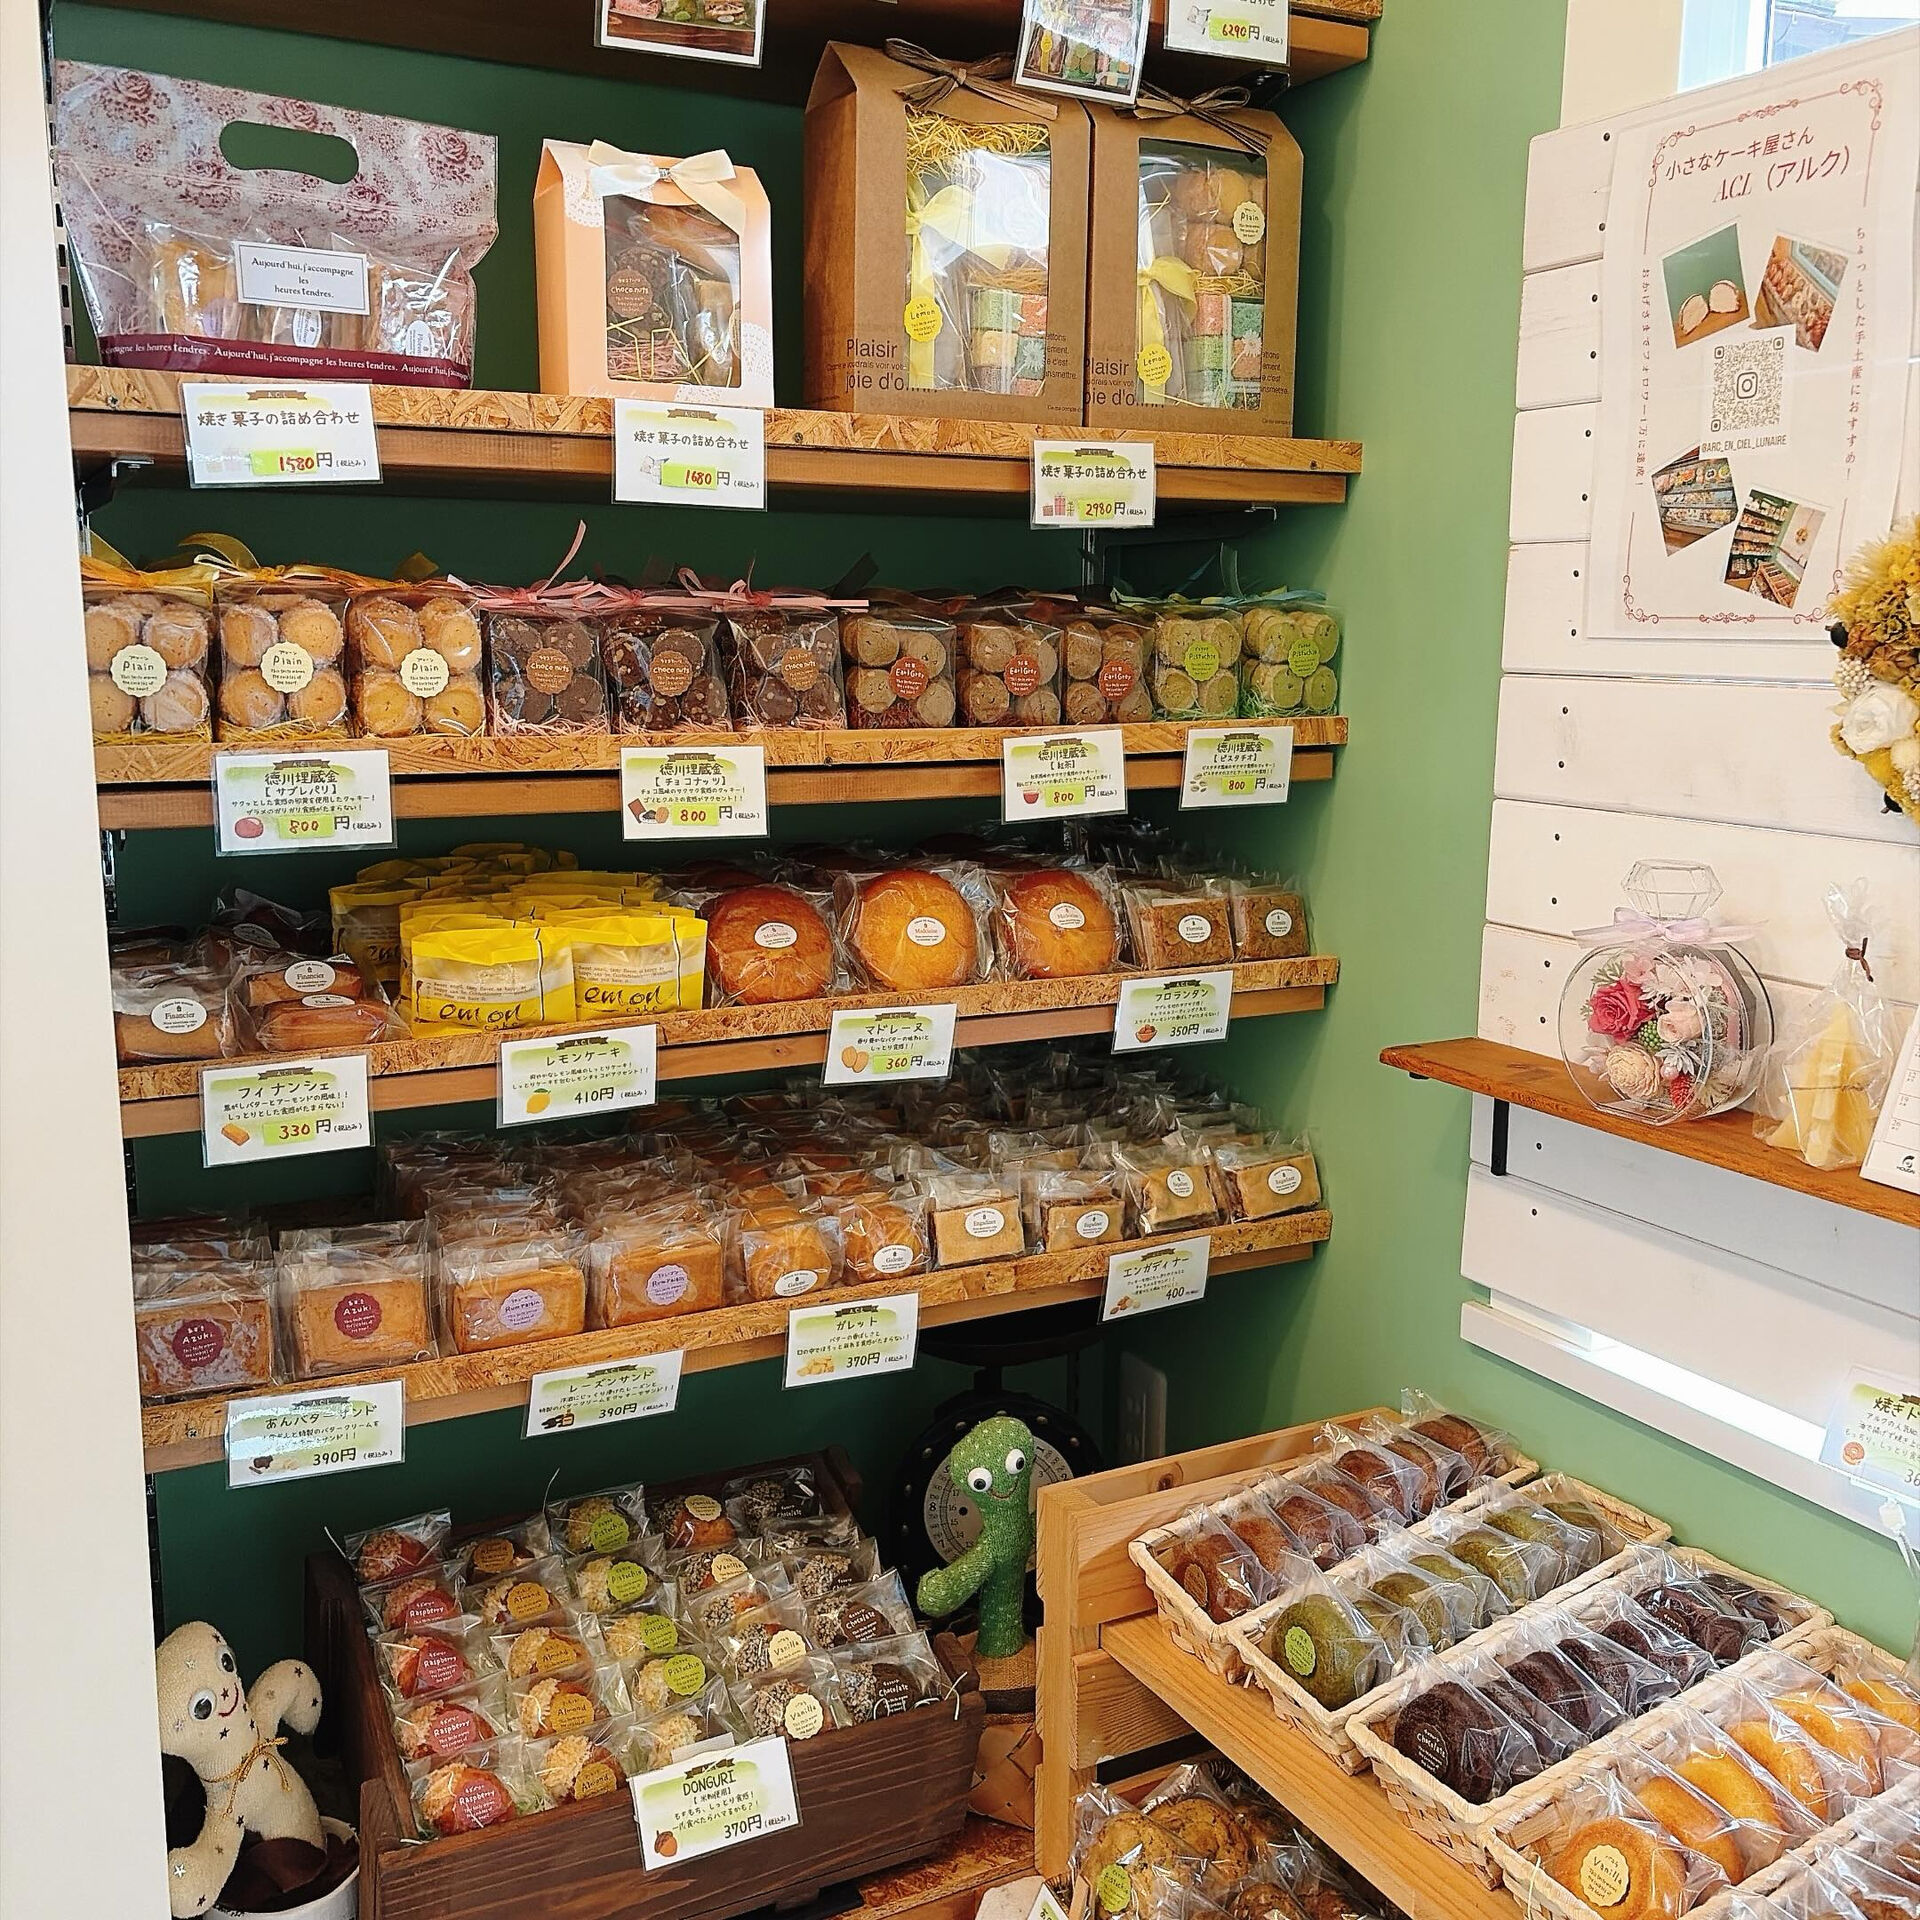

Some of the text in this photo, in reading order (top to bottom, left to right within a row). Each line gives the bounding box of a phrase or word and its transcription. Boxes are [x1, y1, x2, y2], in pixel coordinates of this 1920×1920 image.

[1665, 126, 1815, 181] 小さなケーキ屋さん
[1240, 211, 1259, 221] Plain
[298, 276, 310, 286] les
[274, 284, 335, 299] heures tendres.
[910, 309, 936, 320] Lemon
[846, 338, 898, 358] Plaisir
[1844, 226, 1866, 482] ちょっとした手土産におすすめ！
[326, 356, 337, 366] les
[338, 359, 365, 370] heures
[366, 360, 398, 372] tendres.
[1143, 355, 1166, 367] Lemon
[845, 370, 873, 394] joie
[197, 409, 360, 428] 焼き菓子の詰め合わせ
[633, 430, 749, 450] 焼き菓子の詰め合わせ
[1701, 434, 1787, 453] @ARC_EN_CIEL_LUNAIRE
[1040, 463, 1148, 480] 焼き菓子の詰め合わせ
[122, 660, 154, 672] Plain
[272, 655, 302, 666] Plain
[411, 662, 439, 673] Plain
[1038, 746, 1089, 761] 徳川埋蔵金
[1217, 741, 1265, 754] 徳川埋蔵金
[264, 769, 340, 786] 徳川埋蔵金
[659, 762, 724, 777] 徳川埋蔵金
[655, 776, 726, 787] 【チョコナッツ】
[1155, 988, 1209, 1002] フロランタン
[165, 1011, 195, 1020] Financier
[865, 1022, 924, 1035] マドレーヌ
[1169, 1023, 1200, 1037] 350円
[546, 1048, 621, 1067] レモンケーキ
[238, 1080, 330, 1099] フィナンシェ
[574, 1086, 615, 1104] 410円
[228, 1101, 345, 1121] しっとりとした食感がたまらない！
[1123, 1256, 1190, 1278] エンガディナー
[1166, 1286, 1185, 1300] 400
[343, 1305, 372, 1316] Azuki
[836, 1316, 878, 1331] ガレット
[182, 1332, 214, 1345] Azuki
[846, 1351, 881, 1369] 370円
[569, 1369, 656, 1393] レーズンサンド
[265, 1403, 378, 1430] あんバターサンド
[598, 1402, 638, 1419] 390円
[312, 1447, 357, 1466] 390円
[929, 1501, 937, 1512] 8
[593, 1520, 626, 1540] Pistachio
[715, 1561, 743, 1572] Vanilla
[609, 1568, 645, 1585] Pistachio
[409, 1605, 445, 1618] Raspberry
[644, 1620, 671, 1636] Pistachio
[845, 1611, 877, 1630] Chocolate
[542, 1649, 569, 1663] Almond
[773, 1640, 800, 1656] Vanilla
[422, 1655, 458, 1668] Raspberry
[667, 1661, 701, 1676] Pistachio
[877, 1682, 909, 1698] Chocolate
[556, 1704, 587, 1716] Almond
[789, 1703, 818, 1721] Vanilla
[433, 1718, 471, 1737] Raspberry
[581, 1775, 610, 1792] Almond
[683, 1769, 737, 1797] DONGURI
[459, 1788, 496, 1805] Raspberry
[723, 1813, 763, 1840] 370円
[1594, 1855, 1623, 1885] Vanilla
